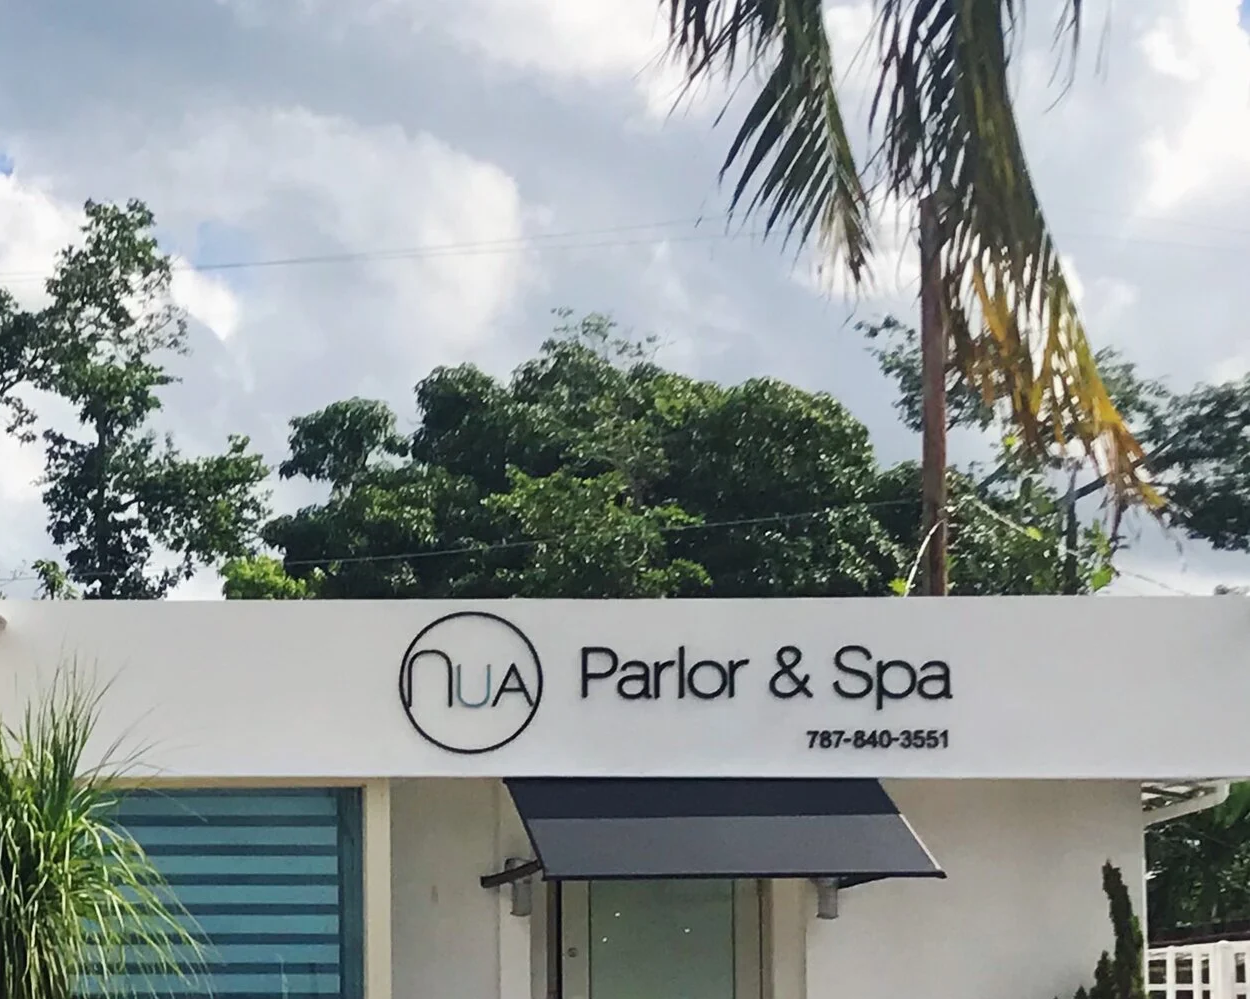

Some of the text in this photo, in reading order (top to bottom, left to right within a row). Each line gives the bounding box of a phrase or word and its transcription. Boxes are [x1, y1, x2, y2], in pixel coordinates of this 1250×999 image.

[580, 645, 954, 711] Parlor & Spa
[806, 729, 949, 750] 787-840-3551
